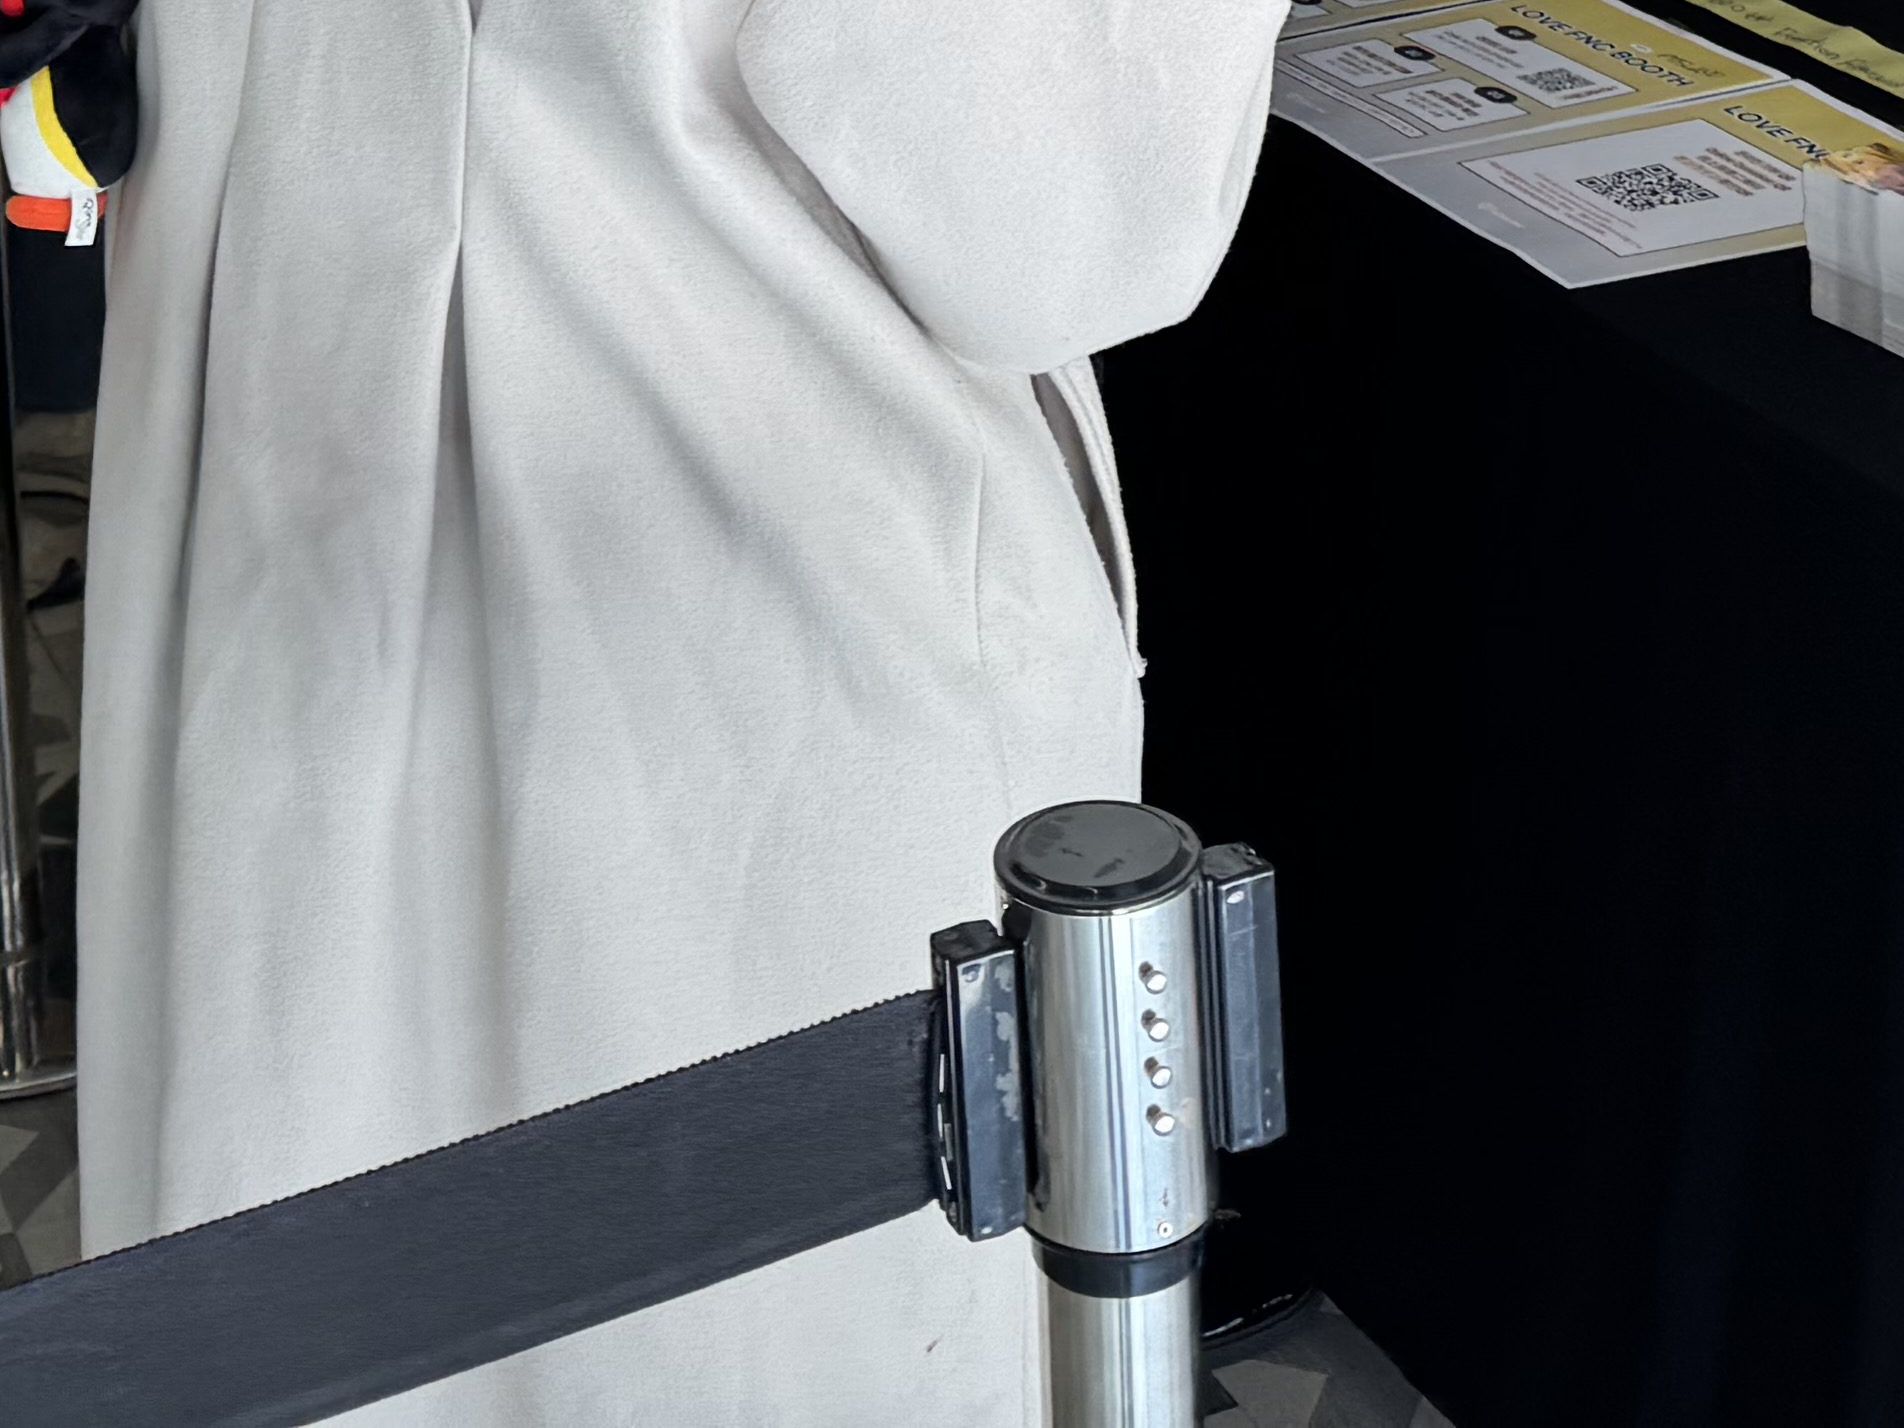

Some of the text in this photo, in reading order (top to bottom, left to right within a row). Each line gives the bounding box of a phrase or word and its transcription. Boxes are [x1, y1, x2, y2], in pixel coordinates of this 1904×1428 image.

[1511, 4, 1572, 32] LOVE
[1565, 30, 1615, 52] FNC
[1610, 50, 1695, 87] BOOTH
[1723, 105, 1794, 138] LOVE
